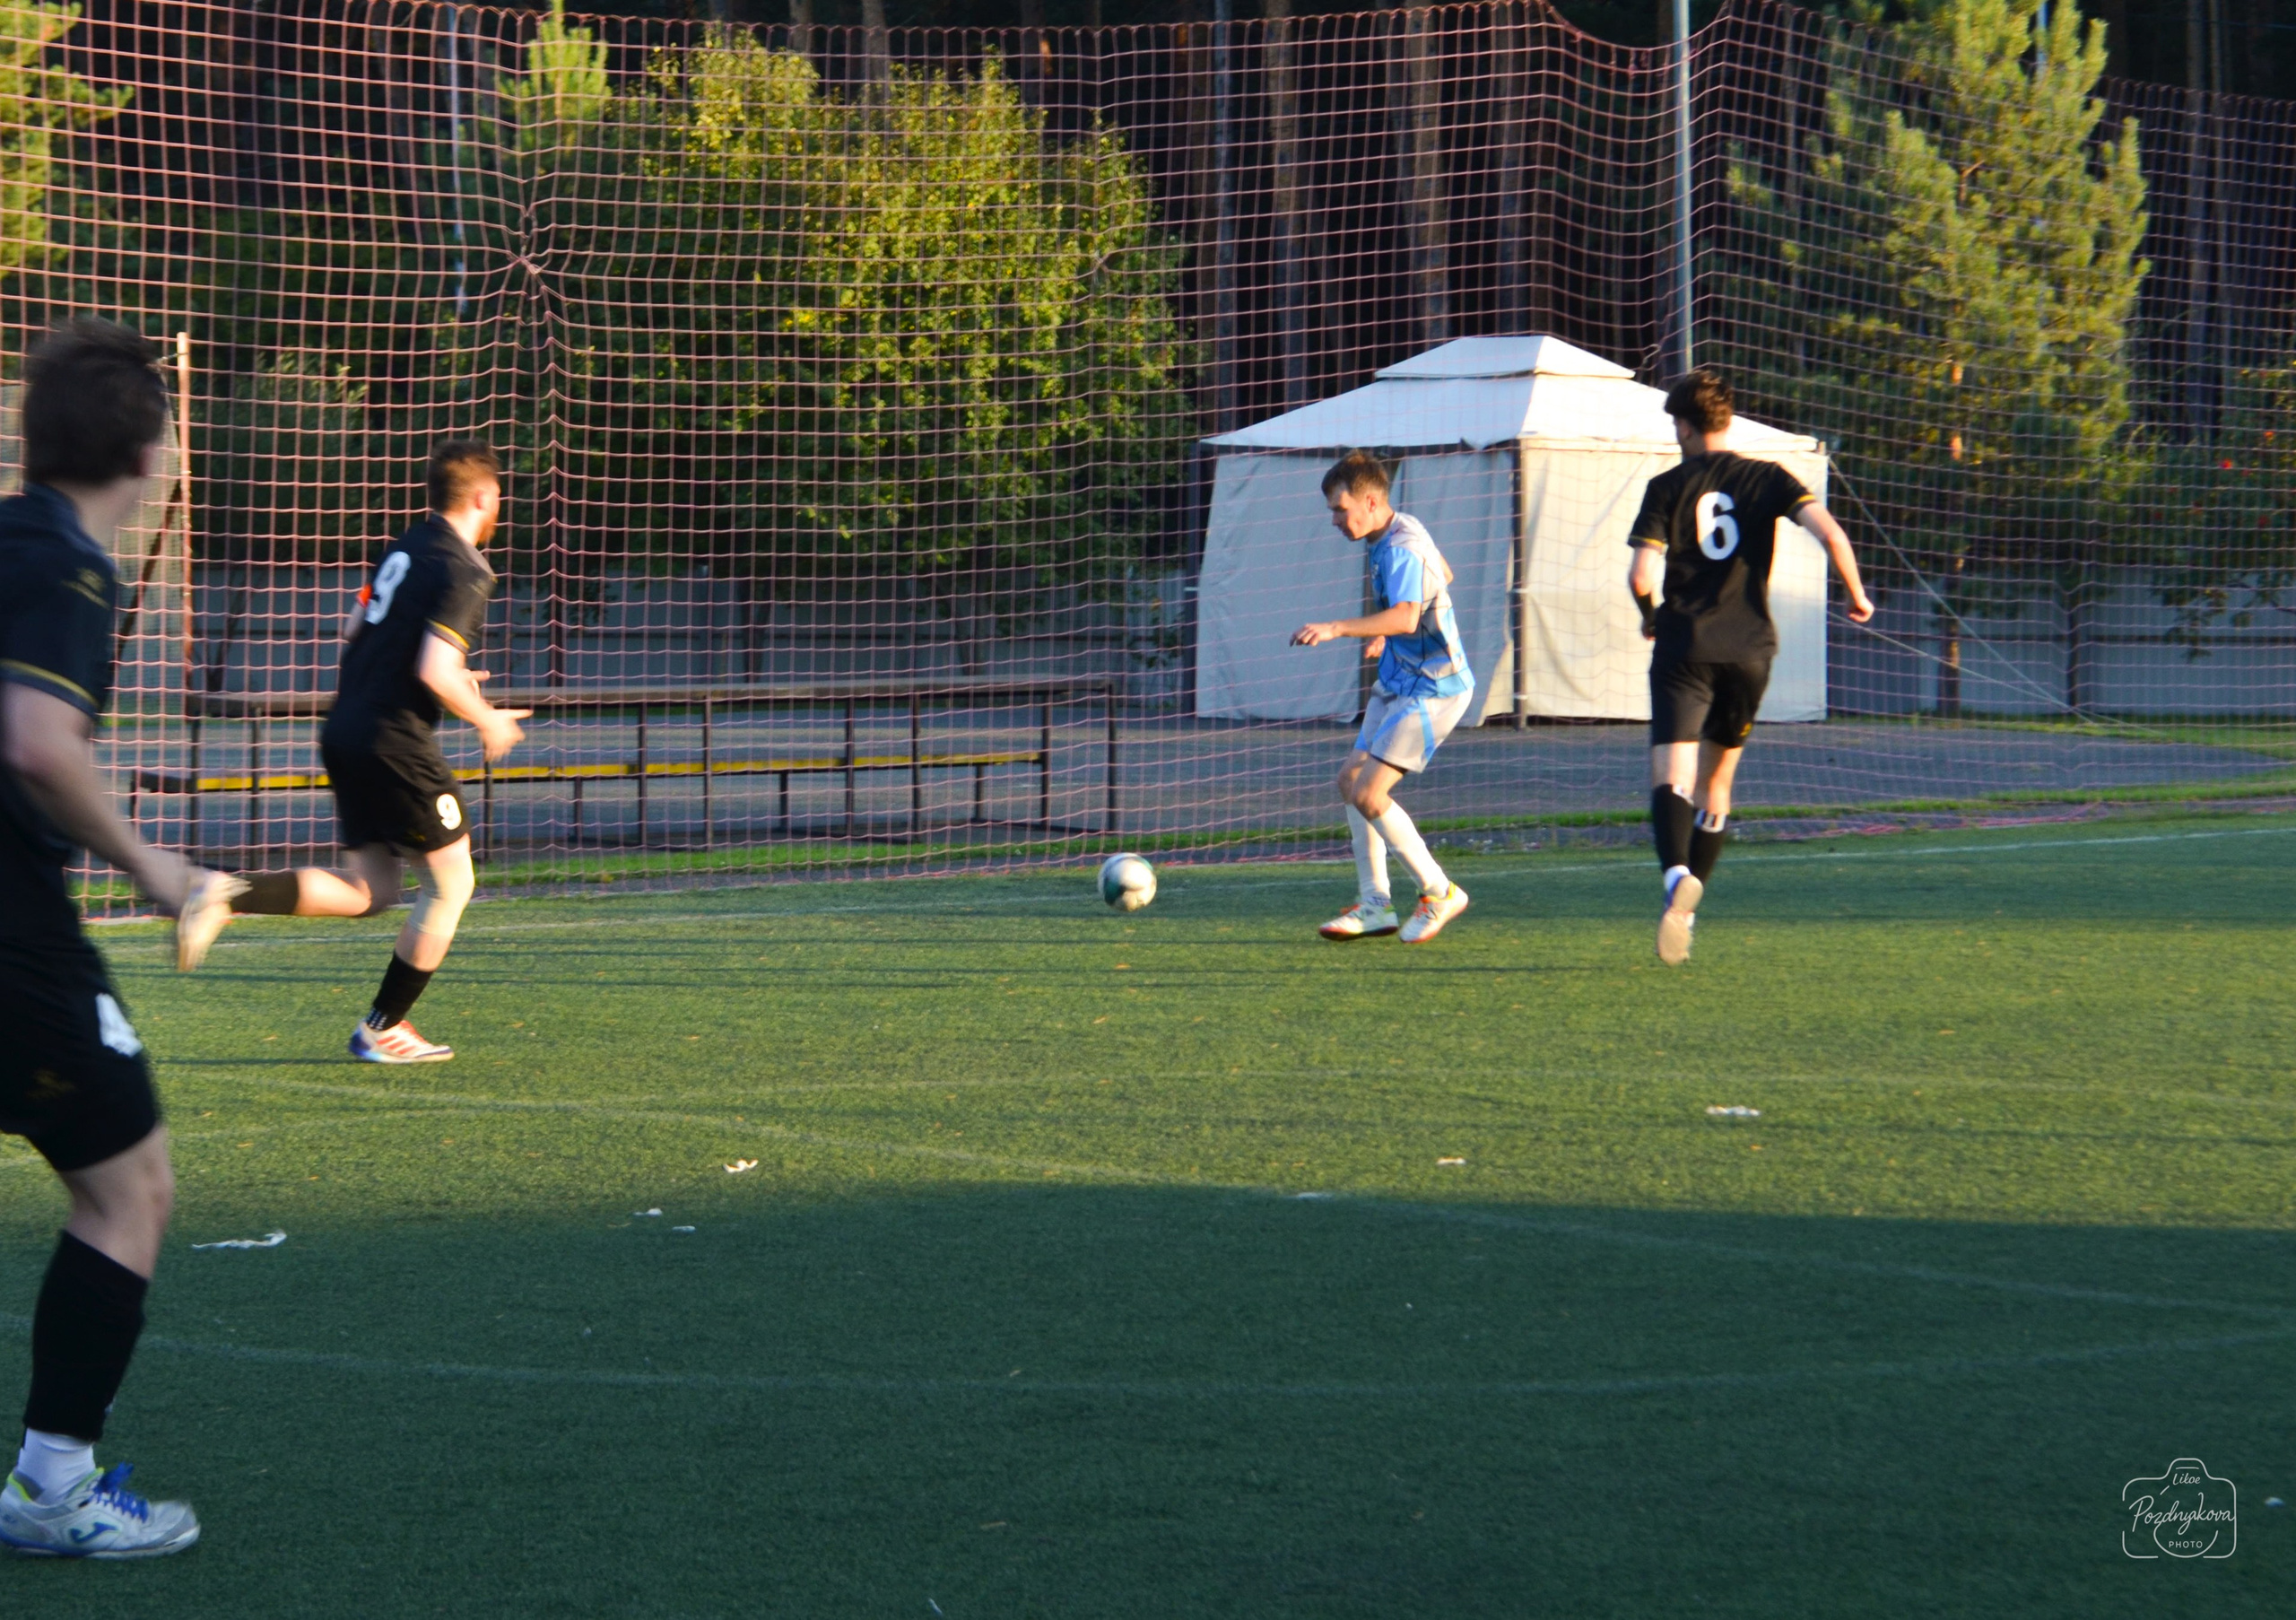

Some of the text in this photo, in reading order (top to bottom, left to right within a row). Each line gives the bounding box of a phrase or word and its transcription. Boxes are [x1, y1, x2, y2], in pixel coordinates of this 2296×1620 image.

[1696, 492, 1739, 560] 6
[365, 551, 411, 624] 9
[436, 793, 462, 830] 9
